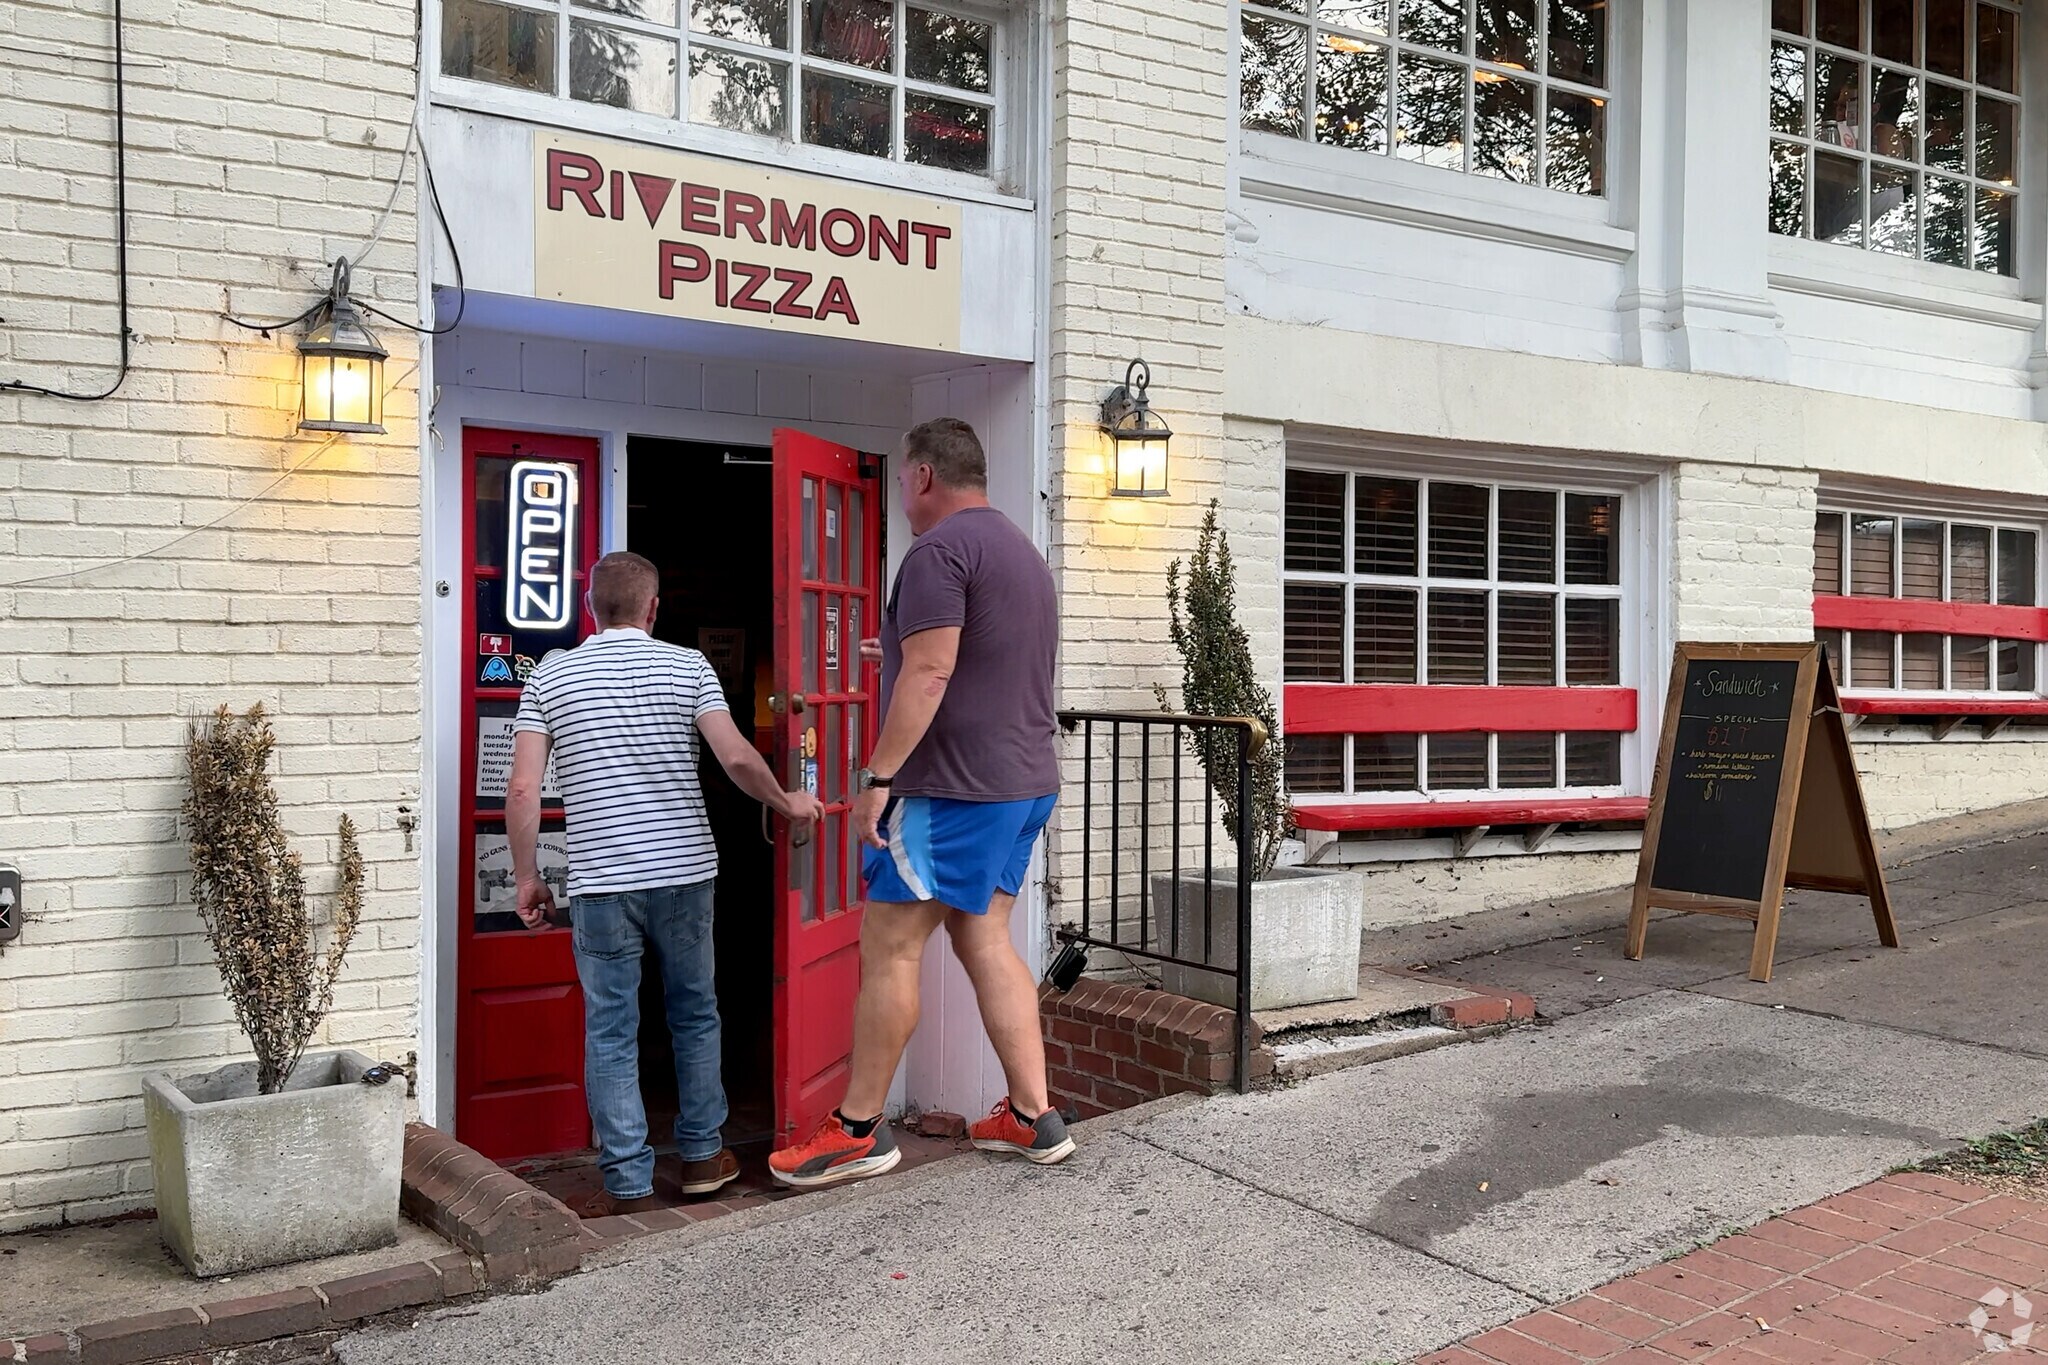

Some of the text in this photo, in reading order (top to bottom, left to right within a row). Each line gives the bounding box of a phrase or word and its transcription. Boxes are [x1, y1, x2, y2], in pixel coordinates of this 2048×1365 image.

[546, 148, 952, 270] RIVERMONT
[658, 239, 860, 325] PIZZA
[519, 474, 562, 620] OPEN
[1702, 670, 1766, 697] Sandwich
[1714, 715, 1758, 723] SPECIAL
[483, 742, 513, 750] tuesday
[481, 768, 504, 776] friday
[481, 785, 508, 793] sunday
[490, 845, 508, 855] GUNS
